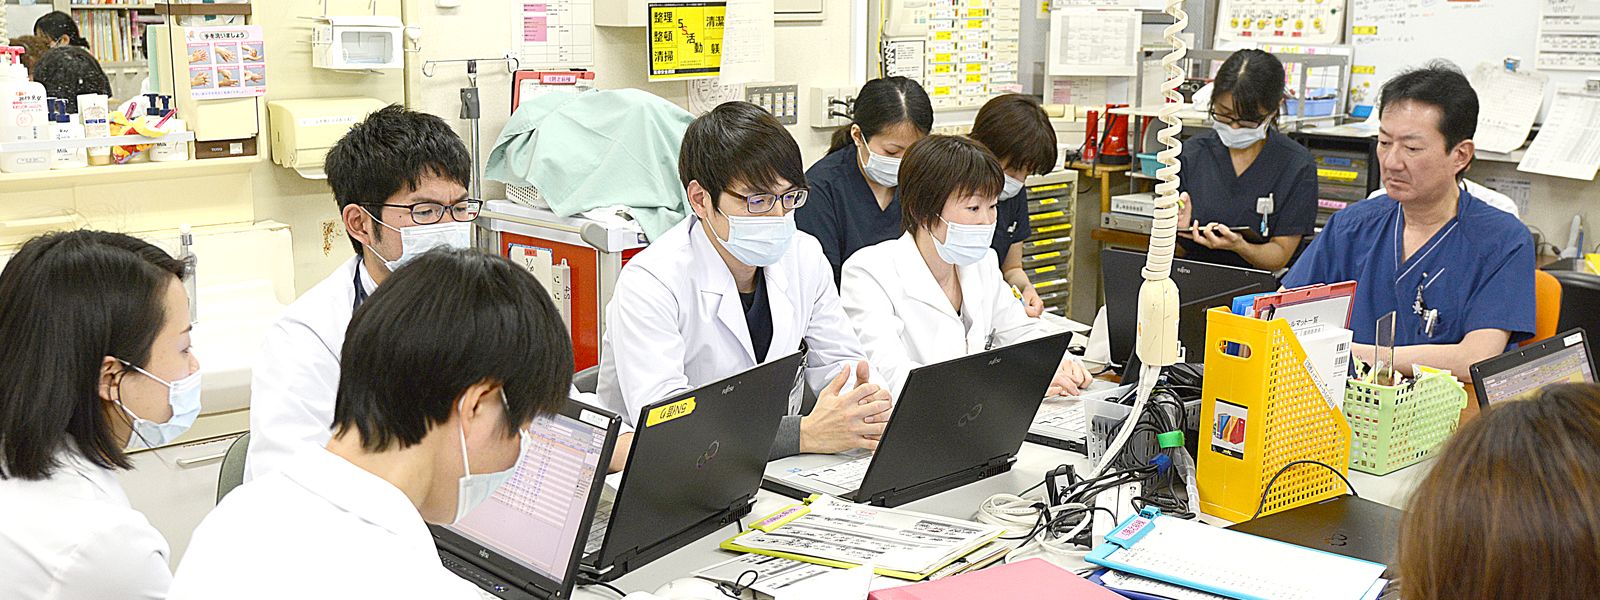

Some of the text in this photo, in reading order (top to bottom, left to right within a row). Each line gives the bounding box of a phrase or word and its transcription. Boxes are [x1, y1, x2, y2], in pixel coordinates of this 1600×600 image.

[654, 12, 673, 23] 整理
[706, 16, 725, 27] 清潔
[654, 31, 673, 42] 整頓
[711, 43, 720, 54] 躾
[654, 50, 673, 62] 清掃
